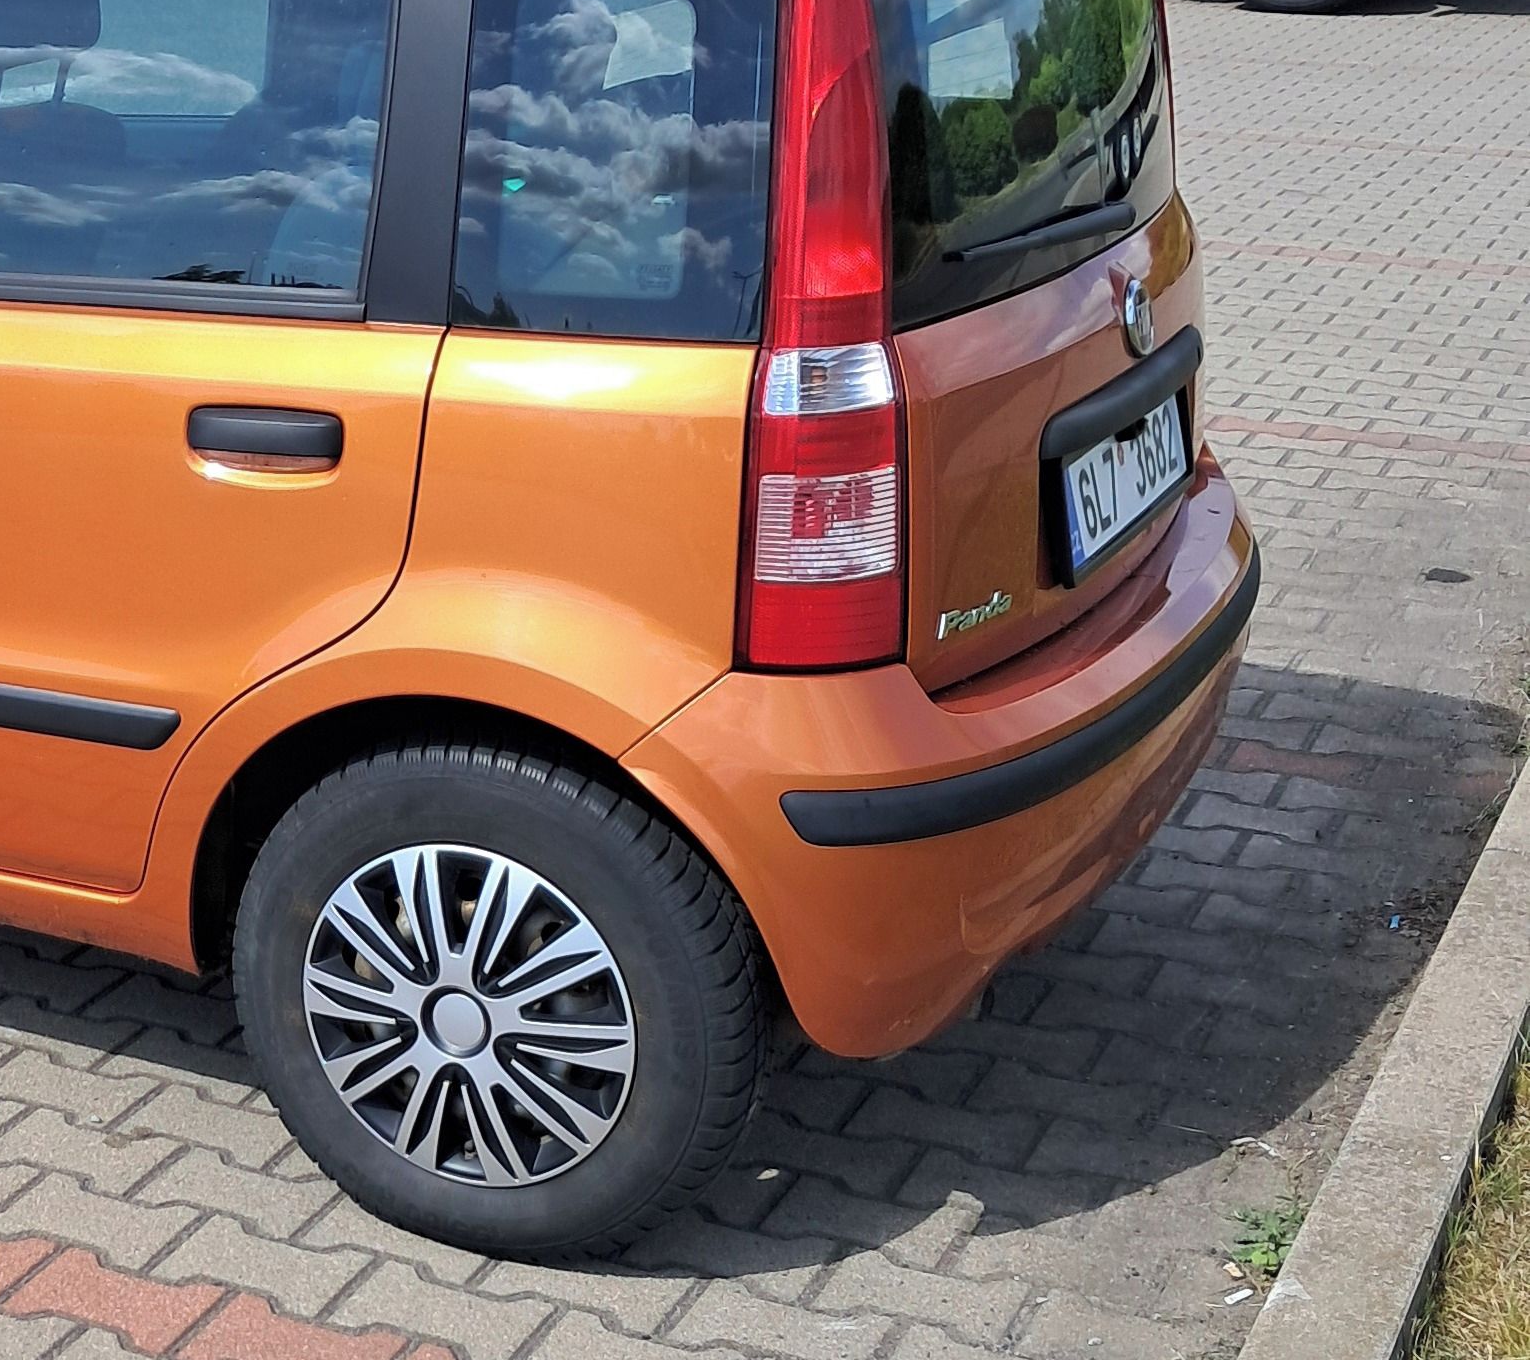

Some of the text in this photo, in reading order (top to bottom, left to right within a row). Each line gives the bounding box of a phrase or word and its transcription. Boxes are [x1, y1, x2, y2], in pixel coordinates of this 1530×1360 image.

[1078, 404, 1178, 539] 6L7 3682
[936, 590, 1013, 640] Panda
